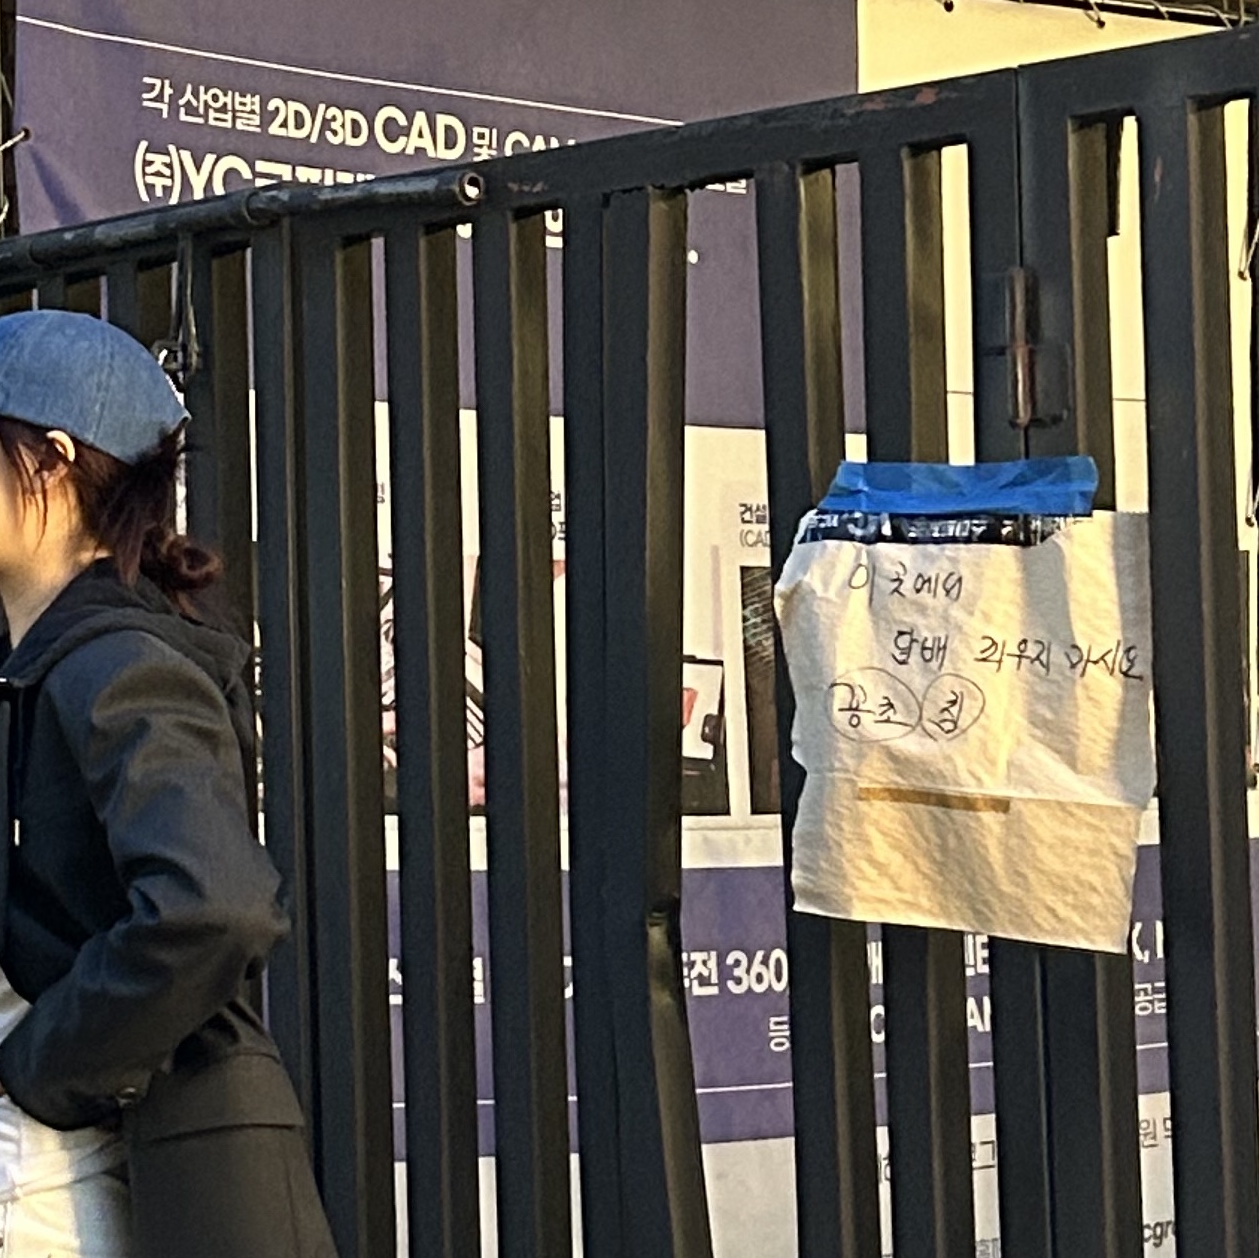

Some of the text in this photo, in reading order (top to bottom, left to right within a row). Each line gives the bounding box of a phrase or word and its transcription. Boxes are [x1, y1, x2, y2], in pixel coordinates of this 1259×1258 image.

[142, 76, 173, 119] 각
[178, 83, 262, 133] 산업별
[267, 97, 369, 147] 2D/3D
[374, 104, 467, 161] CAD
